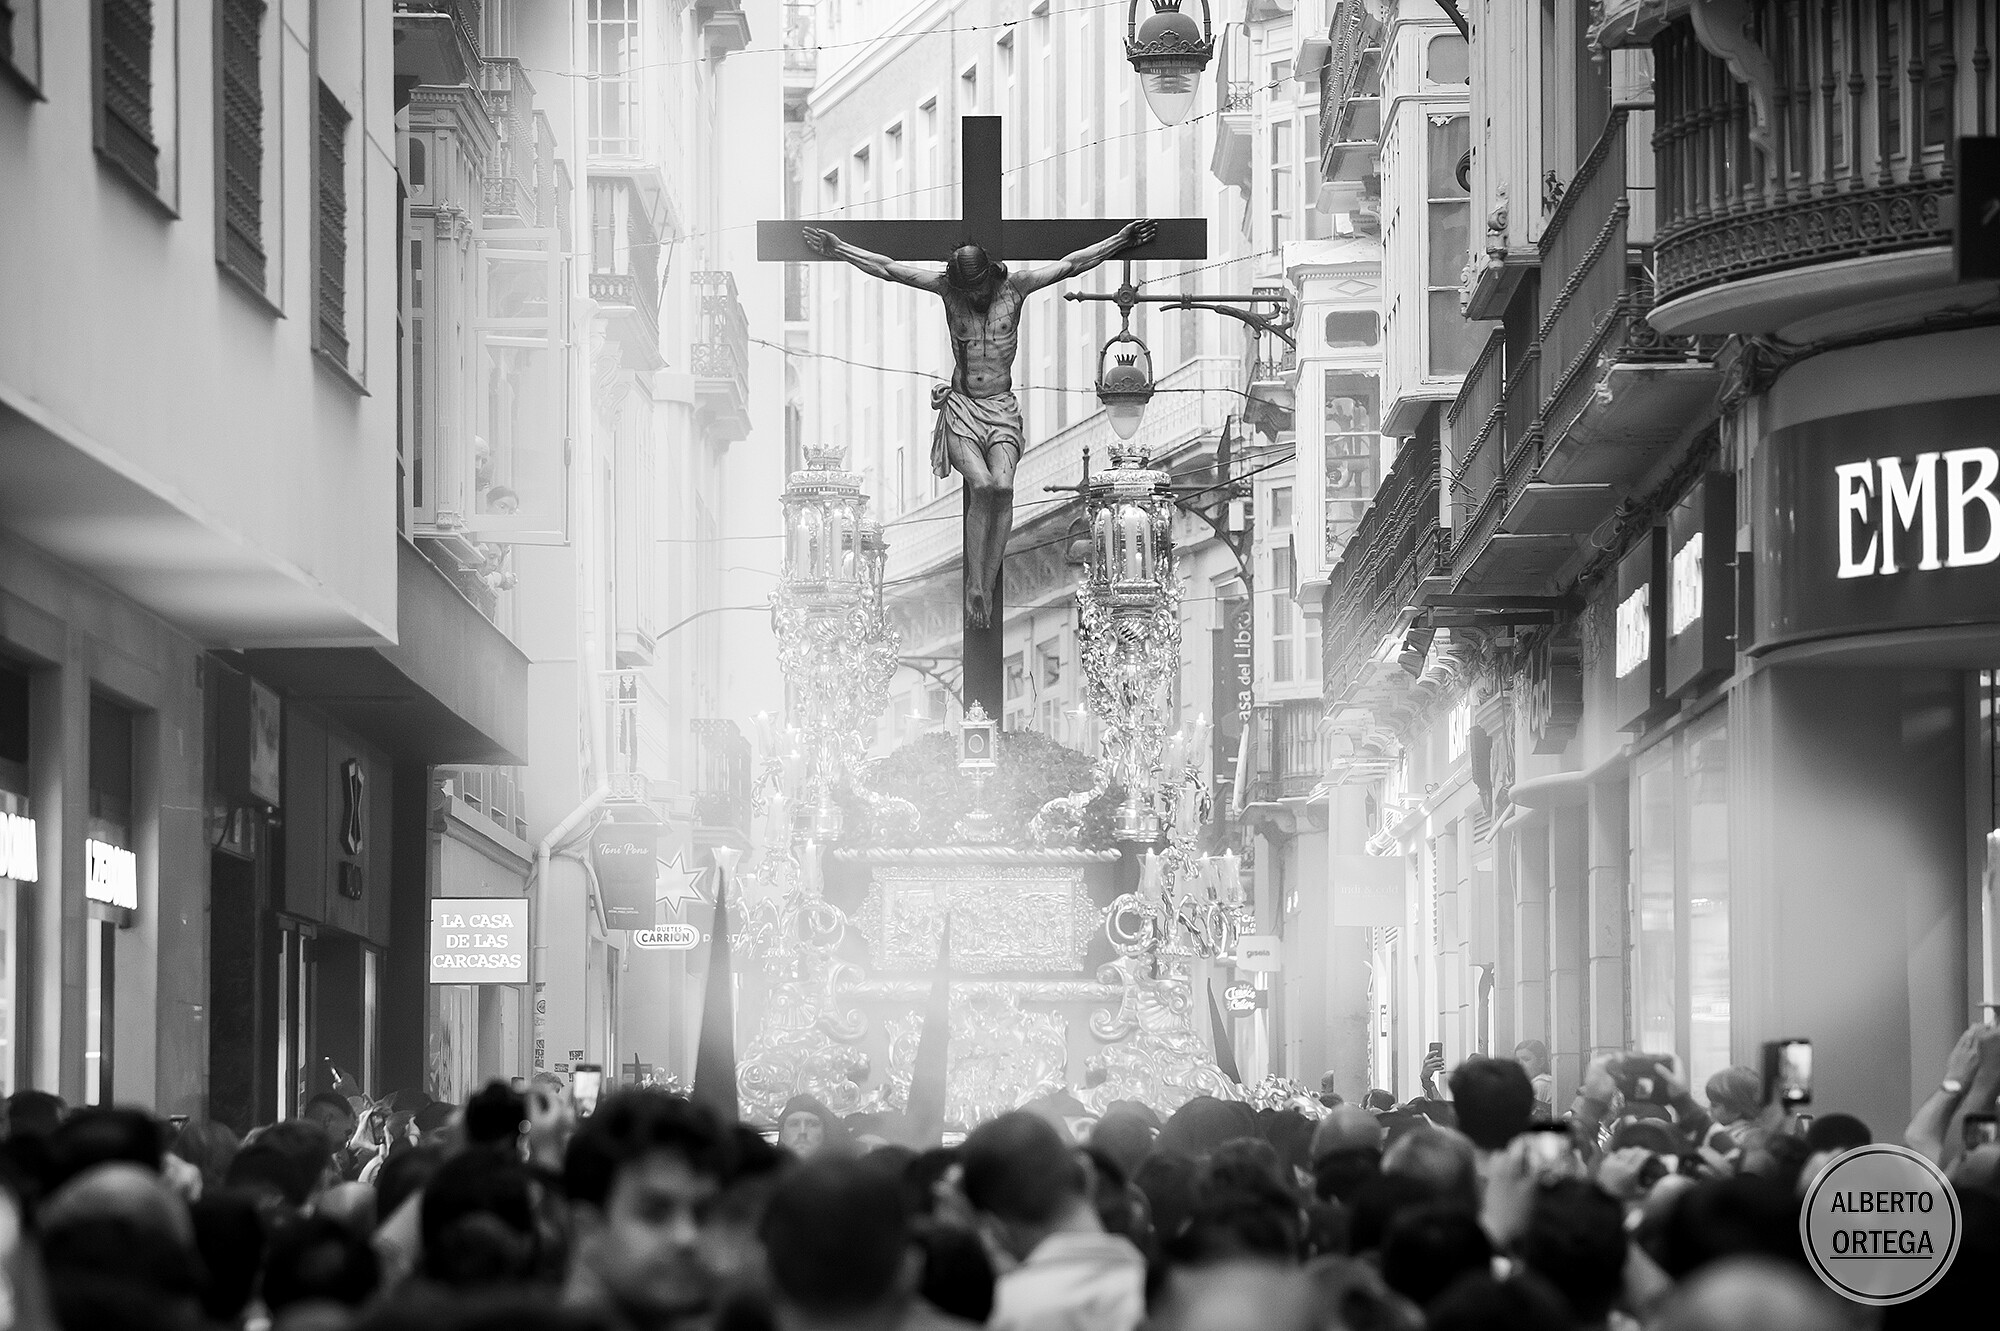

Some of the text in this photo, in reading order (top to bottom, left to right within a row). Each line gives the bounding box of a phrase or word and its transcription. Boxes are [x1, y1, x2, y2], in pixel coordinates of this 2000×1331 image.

[1237, 663, 1251, 685] del
[1238, 690, 1252, 721] asa
[599, 842, 649, 855] Toni Pons
[440, 914, 515, 929] LA CASA
[446, 933, 509, 949] DE LAS
[432, 953, 522, 969] CARCASAS
